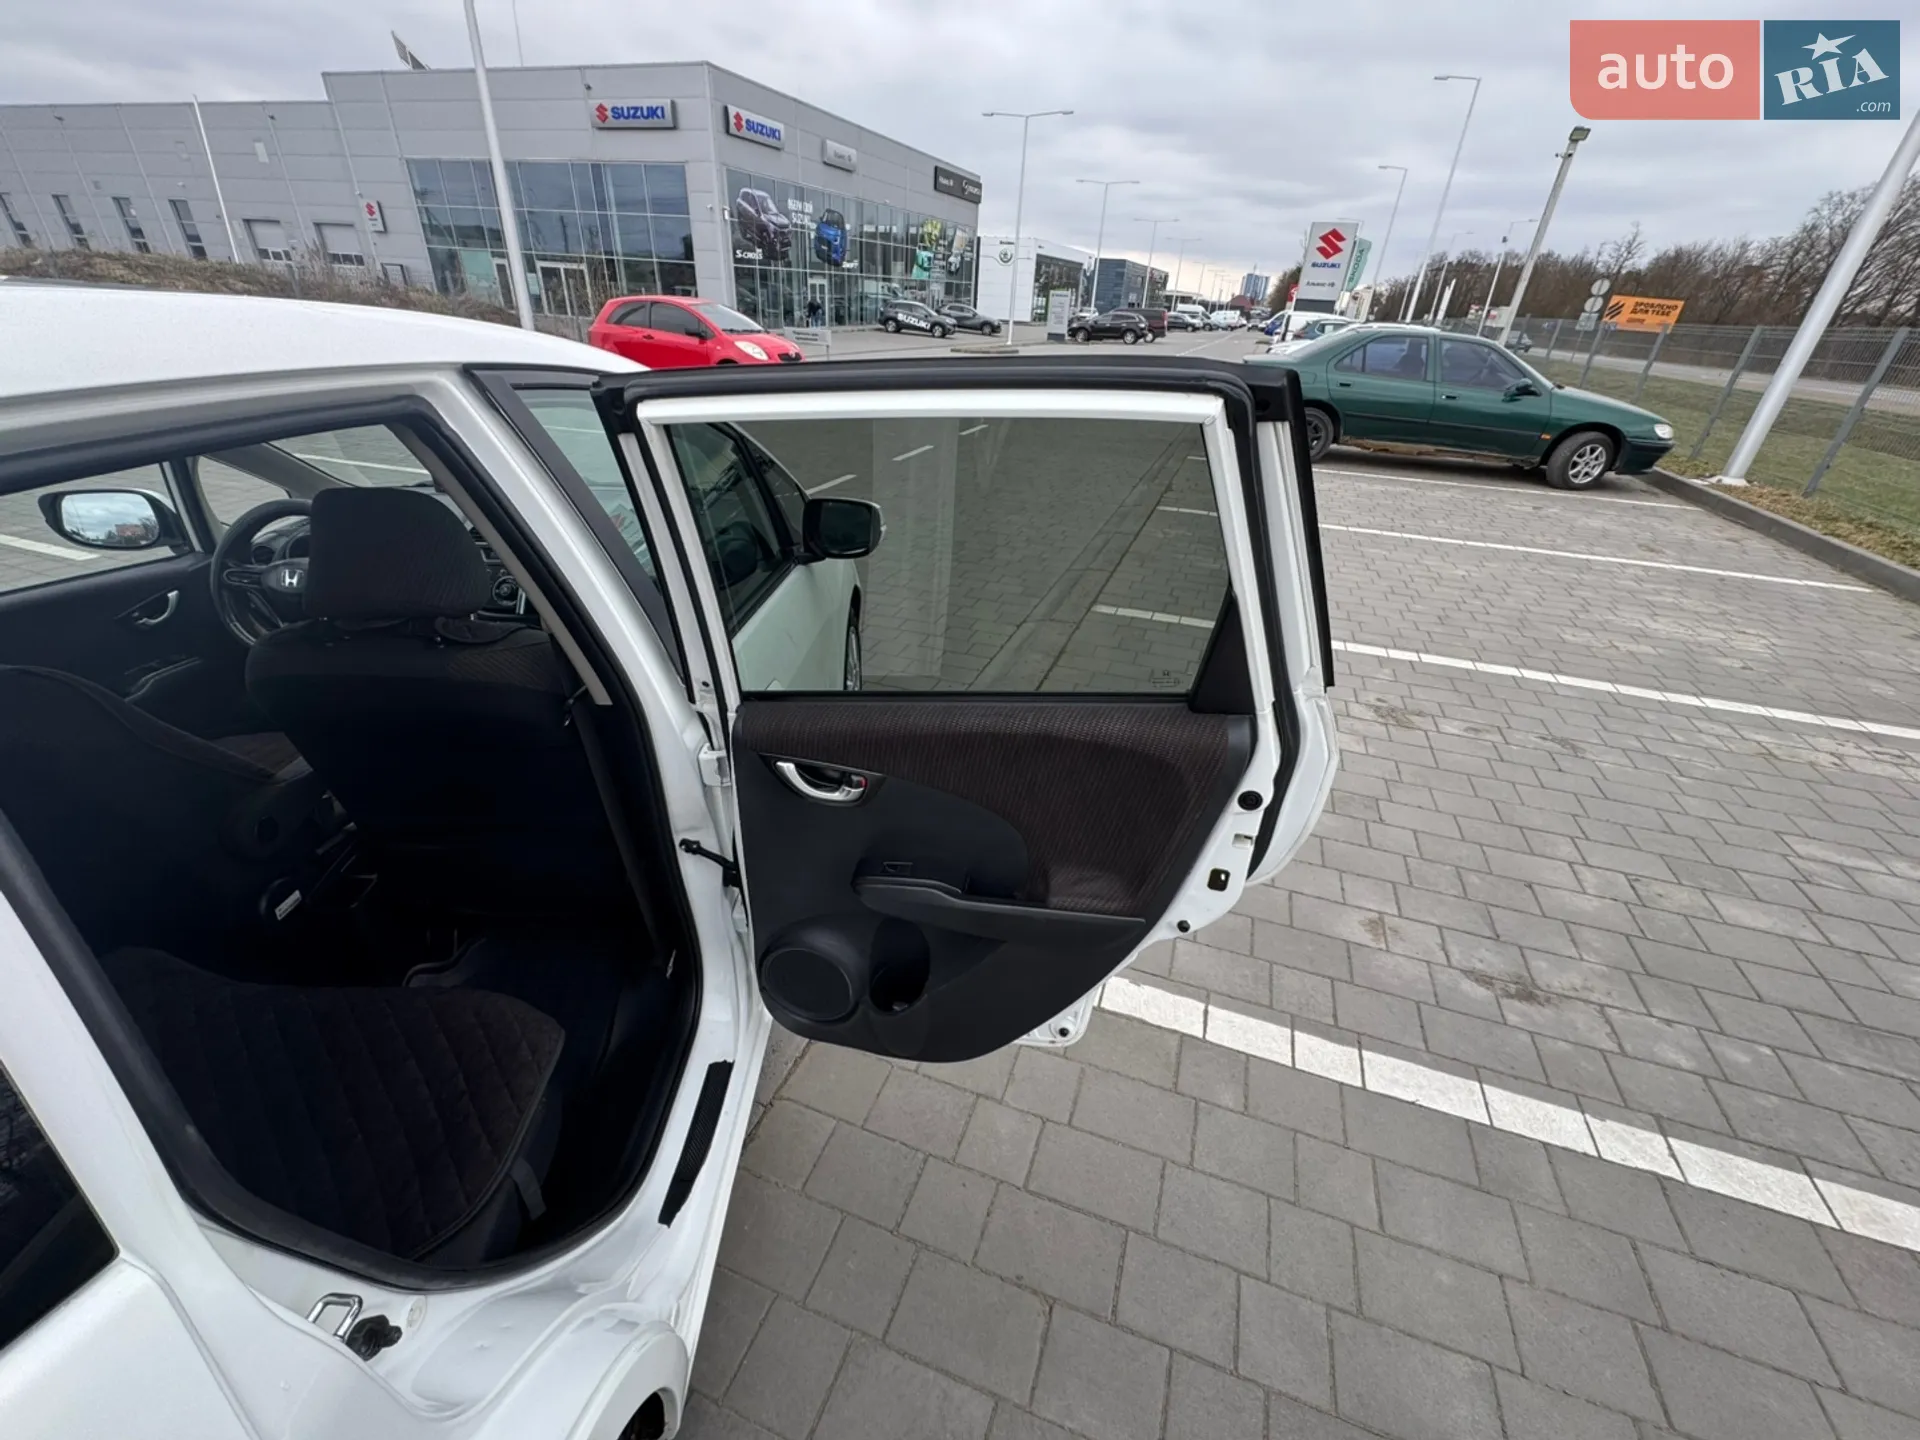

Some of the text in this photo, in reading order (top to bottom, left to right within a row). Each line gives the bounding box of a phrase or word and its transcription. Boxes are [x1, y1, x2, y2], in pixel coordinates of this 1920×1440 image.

[611, 105, 665, 120] SUZUKI
[745, 118, 781, 141] SUZUKI
[1311, 261, 1341, 269] SUZUKI
[897, 313, 930, 330] SUZUKI
